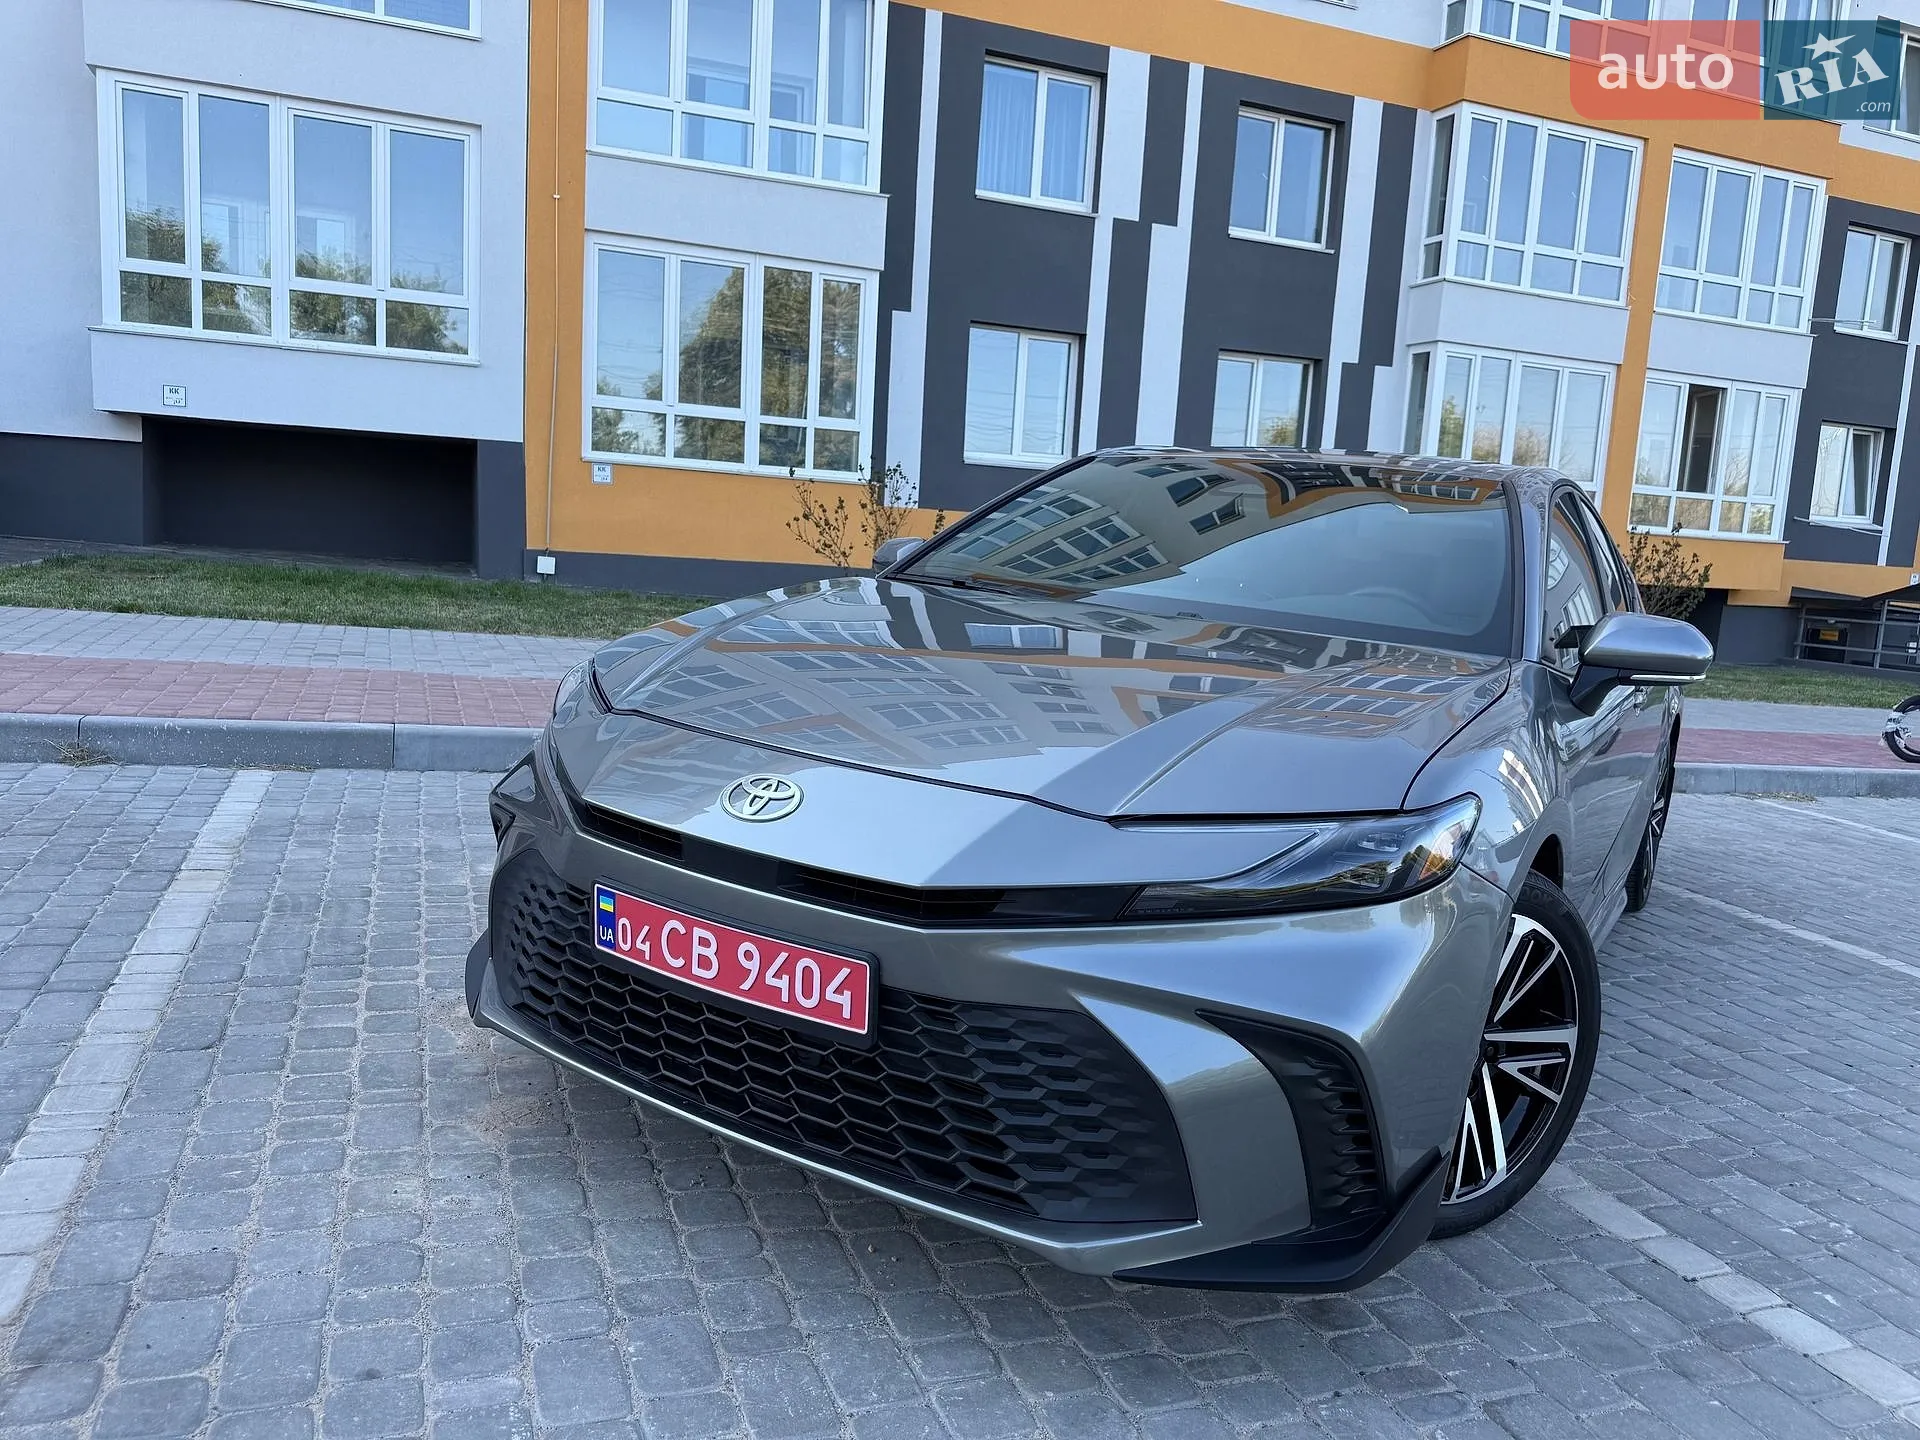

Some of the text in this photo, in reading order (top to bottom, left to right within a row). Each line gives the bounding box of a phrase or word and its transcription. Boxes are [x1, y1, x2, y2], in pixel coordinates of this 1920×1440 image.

[600, 926, 614, 943] UA
[617, 917, 852, 1020] 04 CB 9404
